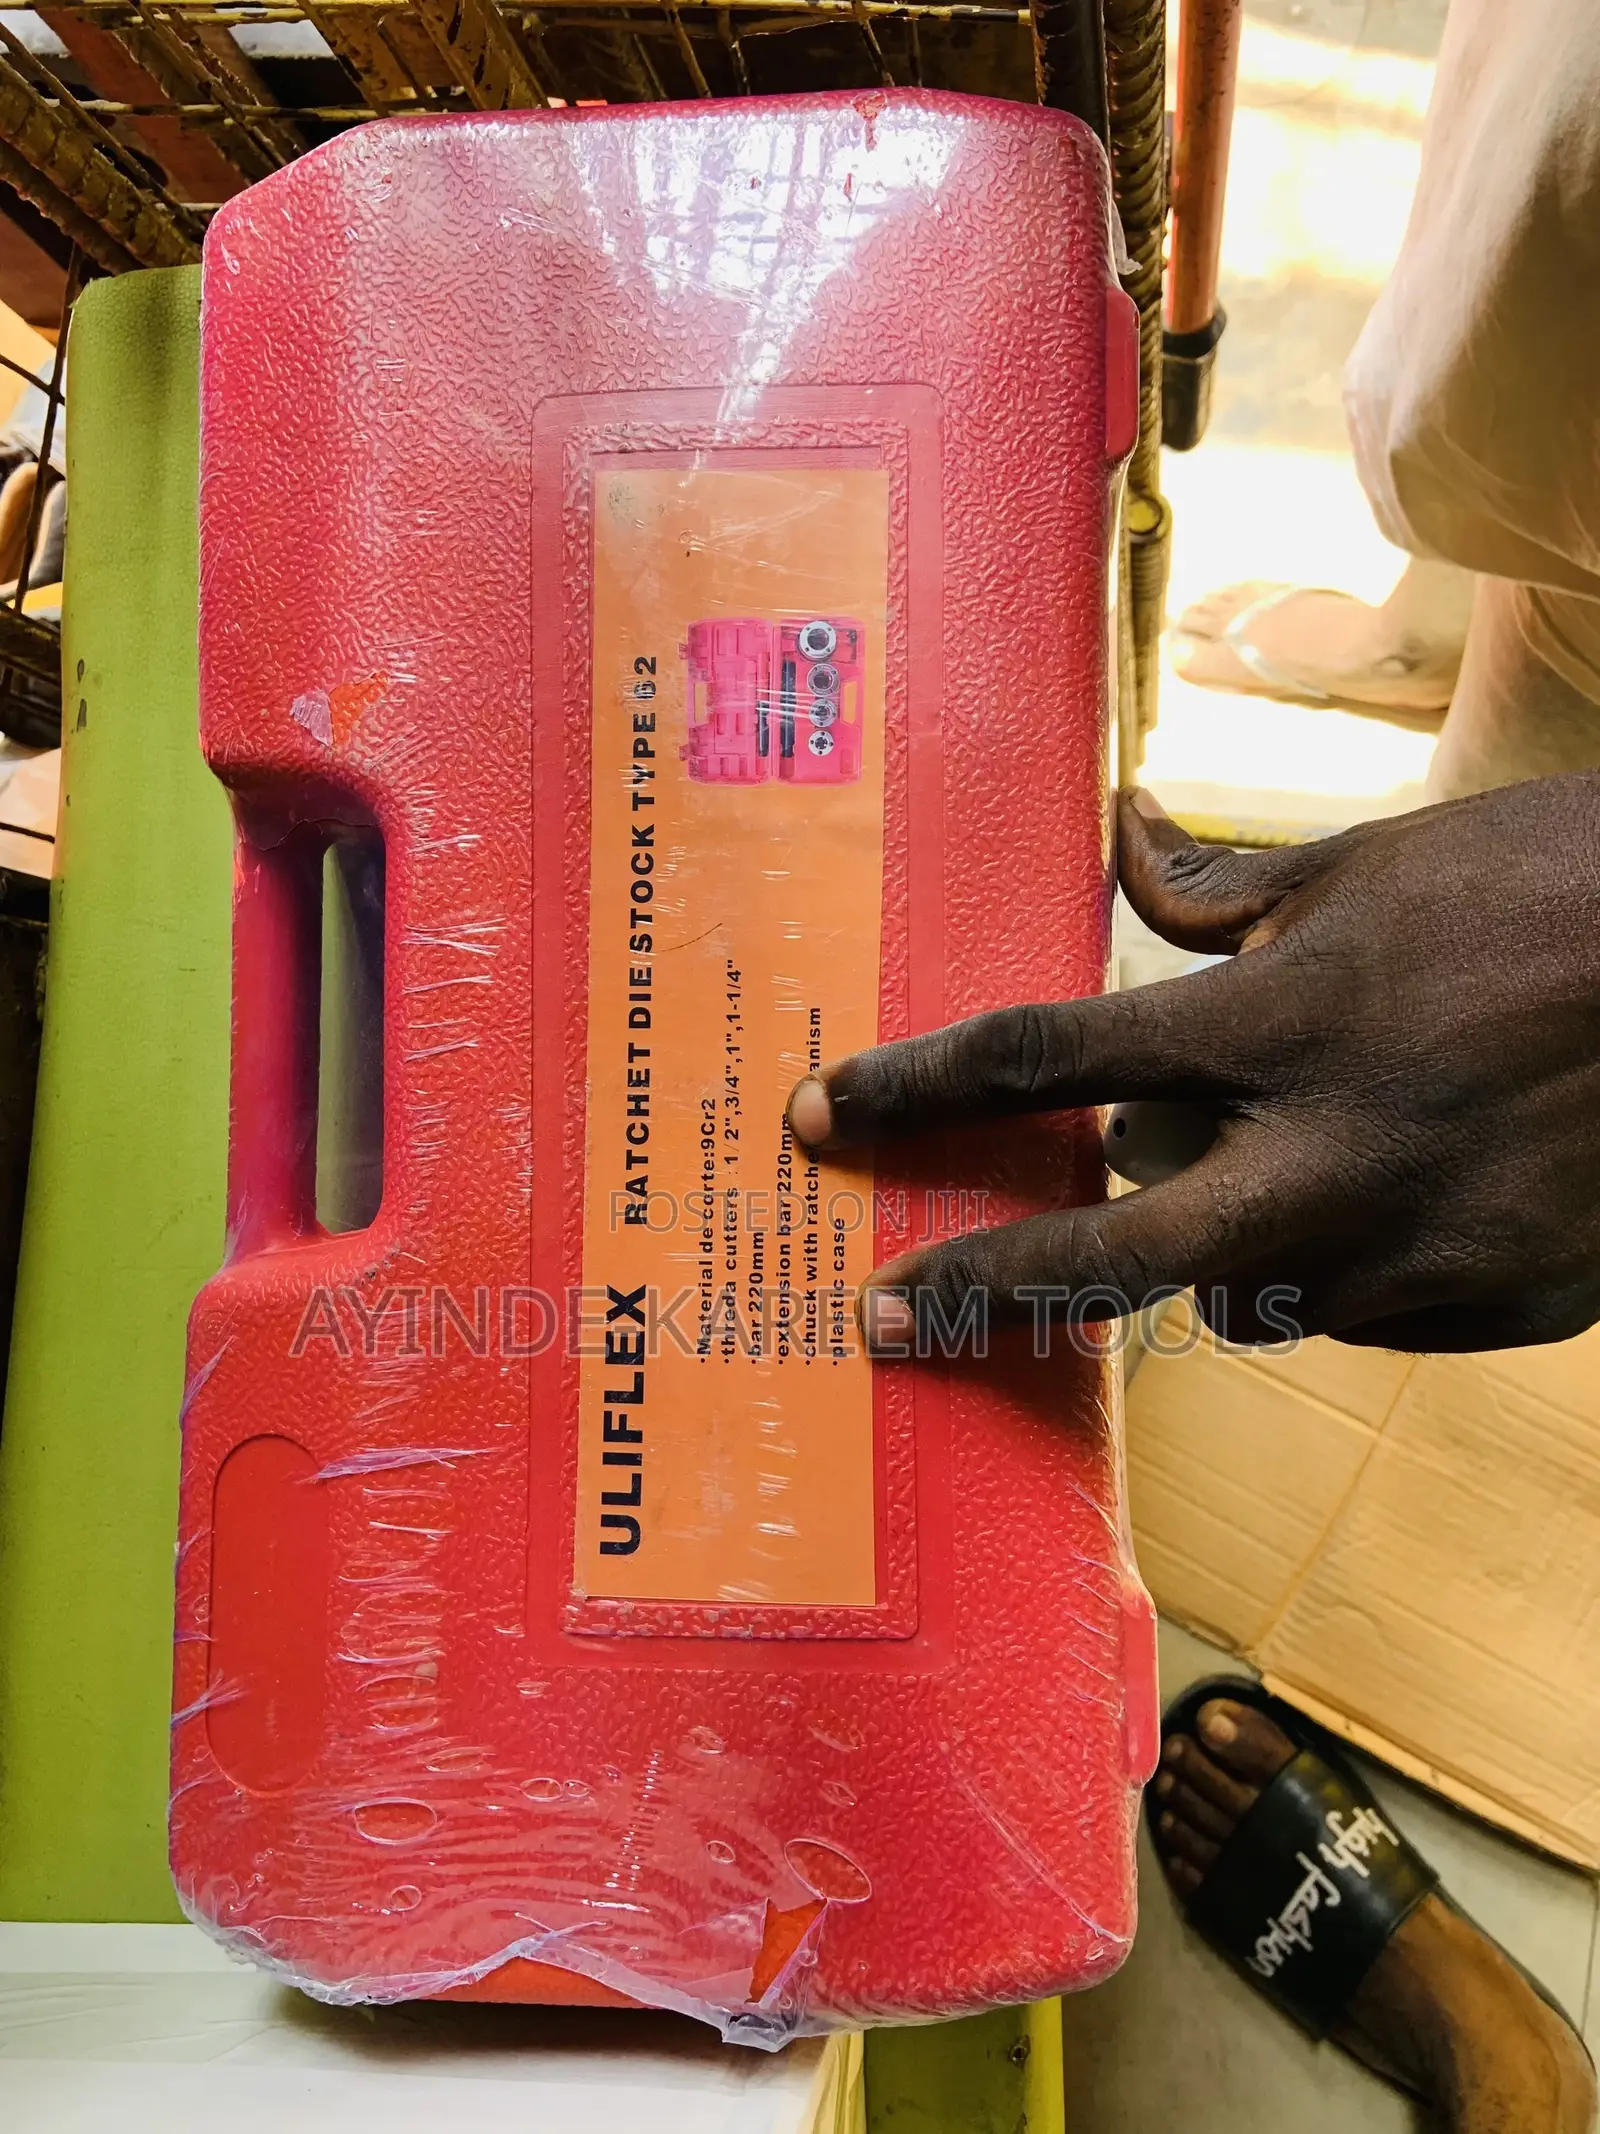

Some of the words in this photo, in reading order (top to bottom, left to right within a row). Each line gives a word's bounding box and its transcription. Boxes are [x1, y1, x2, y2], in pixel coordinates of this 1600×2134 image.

[632, 712, 656, 811] TYPE
[630, 823, 654, 956] STOCK
[629, 966, 652, 1029] DIE
[624, 1042, 651, 1225] RATCHET
[777, 1201, 792, 1236] bar
[804, 1151, 819, 1225] ratche
[699, 1225, 713, 1254] de
[722, 1187, 738, 1271] cutters
[803, 1232, 818, 1282] with
[833, 1218, 845, 1272] case
[696, 1260, 713, 1356] Material
[748, 1232, 764, 1313] 220mm
[776, 1244, 791, 1357] extension
[721, 1280, 737, 1356] threda
[747, 1320, 764, 1356] bar
[802, 1289, 817, 1357] chuck
[830, 1278, 845, 1358] plastic
[600, 1284, 646, 1556] ULIFLEX
